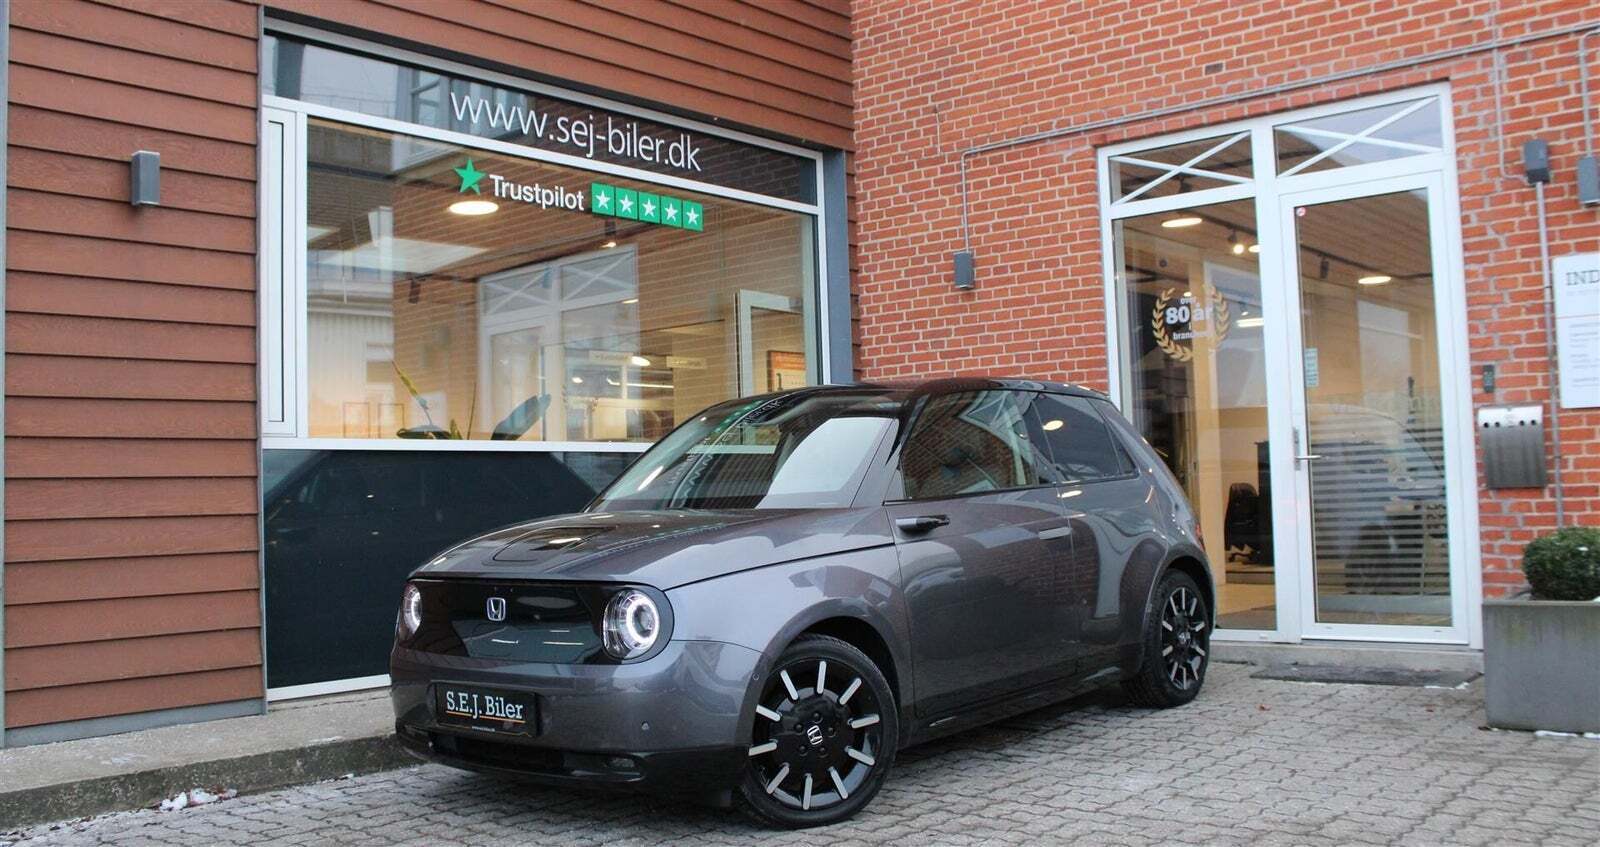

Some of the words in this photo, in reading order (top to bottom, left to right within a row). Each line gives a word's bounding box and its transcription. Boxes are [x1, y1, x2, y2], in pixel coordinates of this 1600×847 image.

[451, 92, 702, 172] www.sej-biler.dk
[489, 174, 585, 212] Trustpilot
[1165, 306, 1190, 325] 80
[446, 691, 482, 719] S.E.J.
[485, 695, 524, 719] Biler
